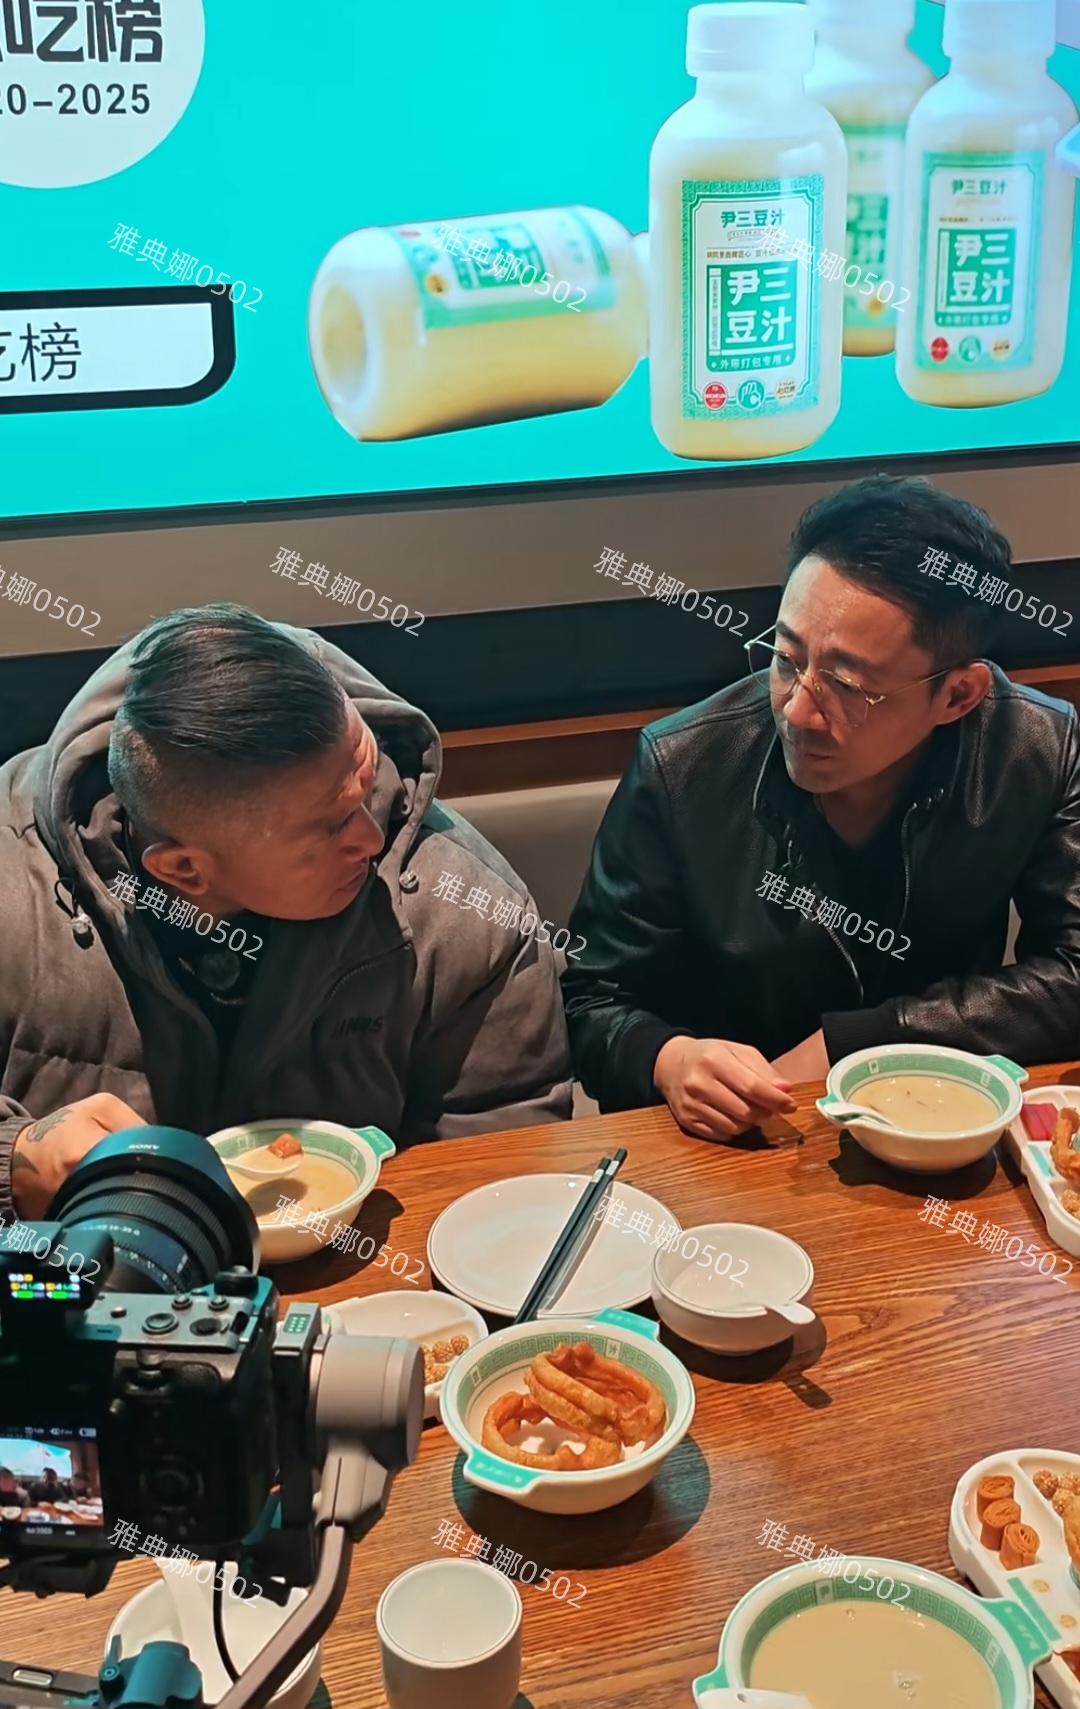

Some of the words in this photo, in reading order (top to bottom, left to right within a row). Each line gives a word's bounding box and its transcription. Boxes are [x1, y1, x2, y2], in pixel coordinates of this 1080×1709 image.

[0, 0, 163, 62] 吃榜
[0, 83, 151, 115] 0-2025
[720, 208, 785, 229] 尹三豆汁
[954, 233, 1010, 266] 尹三
[727, 266, 792, 305] 尹三
[950, 269, 1011, 302] 豆汁
[725, 306, 792, 344] 豆汁
